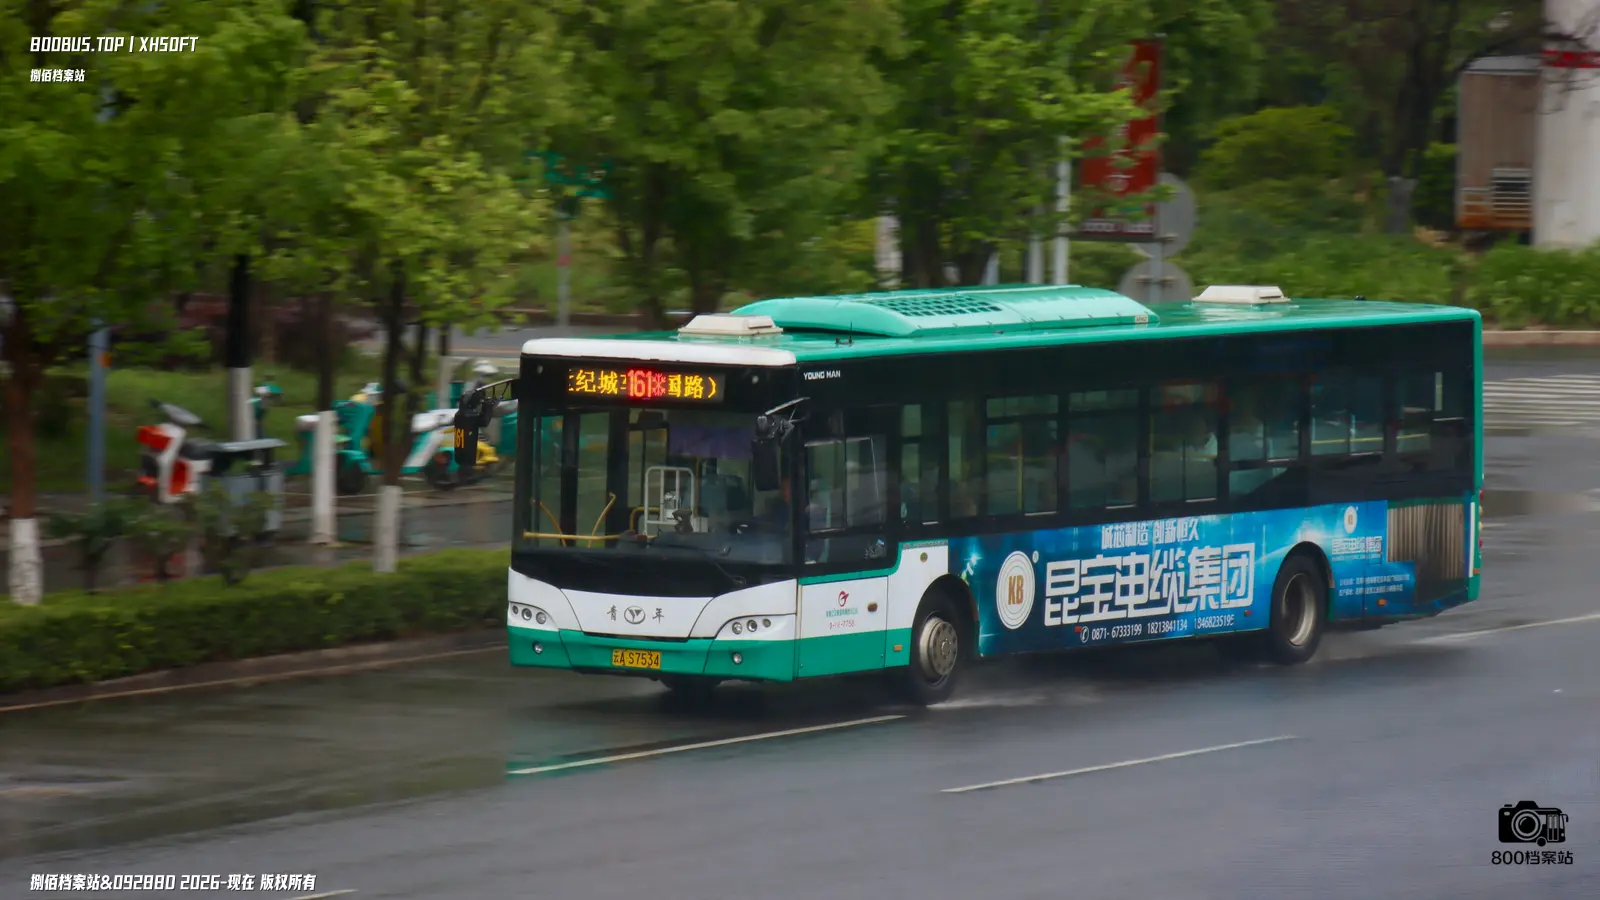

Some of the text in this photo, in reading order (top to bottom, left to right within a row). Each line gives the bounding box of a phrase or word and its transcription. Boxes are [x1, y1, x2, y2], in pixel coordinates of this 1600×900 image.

[627, 369, 653, 397] 161
[803, 370, 841, 380] YOUNG MAN
[1008, 574, 1024, 605] KB
[1044, 543, 1256, 626] 昆宝电缆集团
[1111, 623, 1142, 638] 67333199
[1147, 619, 1188, 634] 18213841134
